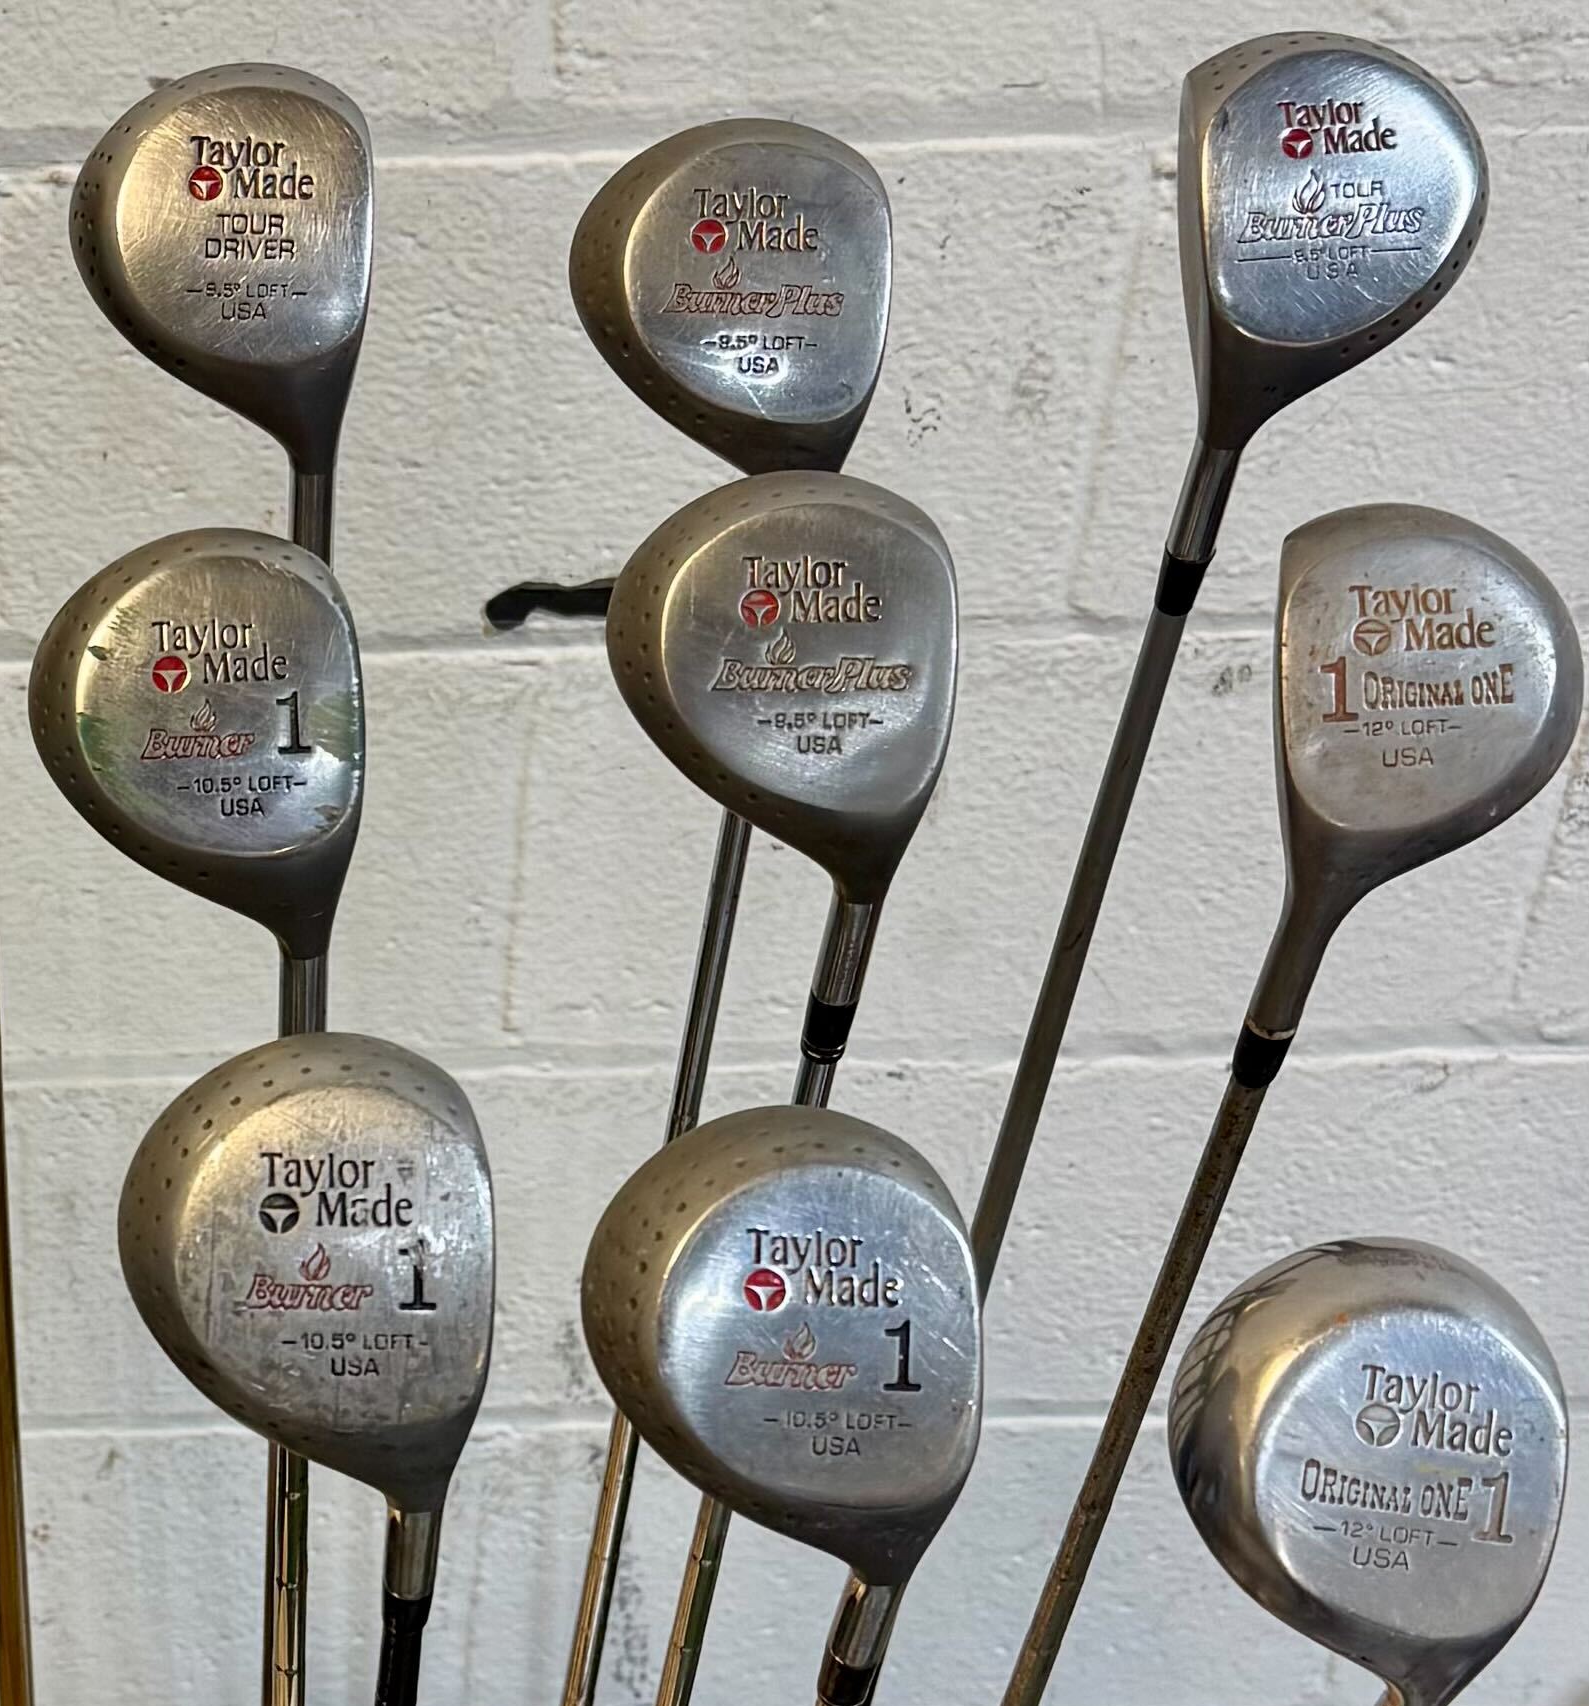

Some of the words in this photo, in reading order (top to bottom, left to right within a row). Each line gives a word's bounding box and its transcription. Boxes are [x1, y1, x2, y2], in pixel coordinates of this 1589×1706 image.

[1276, 98, 1364, 133] Taylor
[190, 136, 285, 172] Taylor
[1323, 117, 1397, 155] Made
[234, 162, 314, 200] Made
[1330, 180, 1383, 198] TOUR
[216, 214, 284, 235] TOUR
[693, 187, 789, 224] Taylor
[205, 238, 296, 260] DRIVER
[736, 213, 820, 252] Made
[1306, 263, 1359, 281] USA
[221, 303, 266, 320] USA
[737, 357, 780, 374] USA
[741, 556, 848, 597] Taylor
[791, 581, 882, 623] Made
[1348, 583, 1458, 623] Taylor
[151, 618, 254, 658] Taylor
[1403, 608, 1495, 652] Made
[203, 642, 289, 684] Made
[1318, 655, 1360, 723] 1
[1362, 671, 1464, 711] ORIGINAL
[1471, 663, 1514, 706] ONE
[141, 728, 255, 760] Burner
[275, 690, 312, 755] 1
[800, 736, 843, 755] USA
[1381, 747, 1434, 768] USA
[220, 798, 265, 817] USA
[260, 1152, 375, 1198] Taylor
[316, 1183, 413, 1228] Made
[745, 1228, 864, 1275] Taylor
[245, 1273, 372, 1311] Burner
[398, 1240, 438, 1311] 1
[805, 1260, 904, 1308] Made
[330, 1357, 381, 1377] USA
[724, 1350, 858, 1393] Burner
[882, 1319, 922, 1393] 1
[1361, 1364, 1480, 1414] Taylor
[812, 1437, 861, 1457] USA
[1411, 1410, 1513, 1457] Made
[1301, 1458, 1411, 1515] ORIGINAL
[1420, 1477, 1473, 1521] ONE
[1473, 1471, 1513, 1544] 1
[1352, 1546, 1410, 1571] USA
